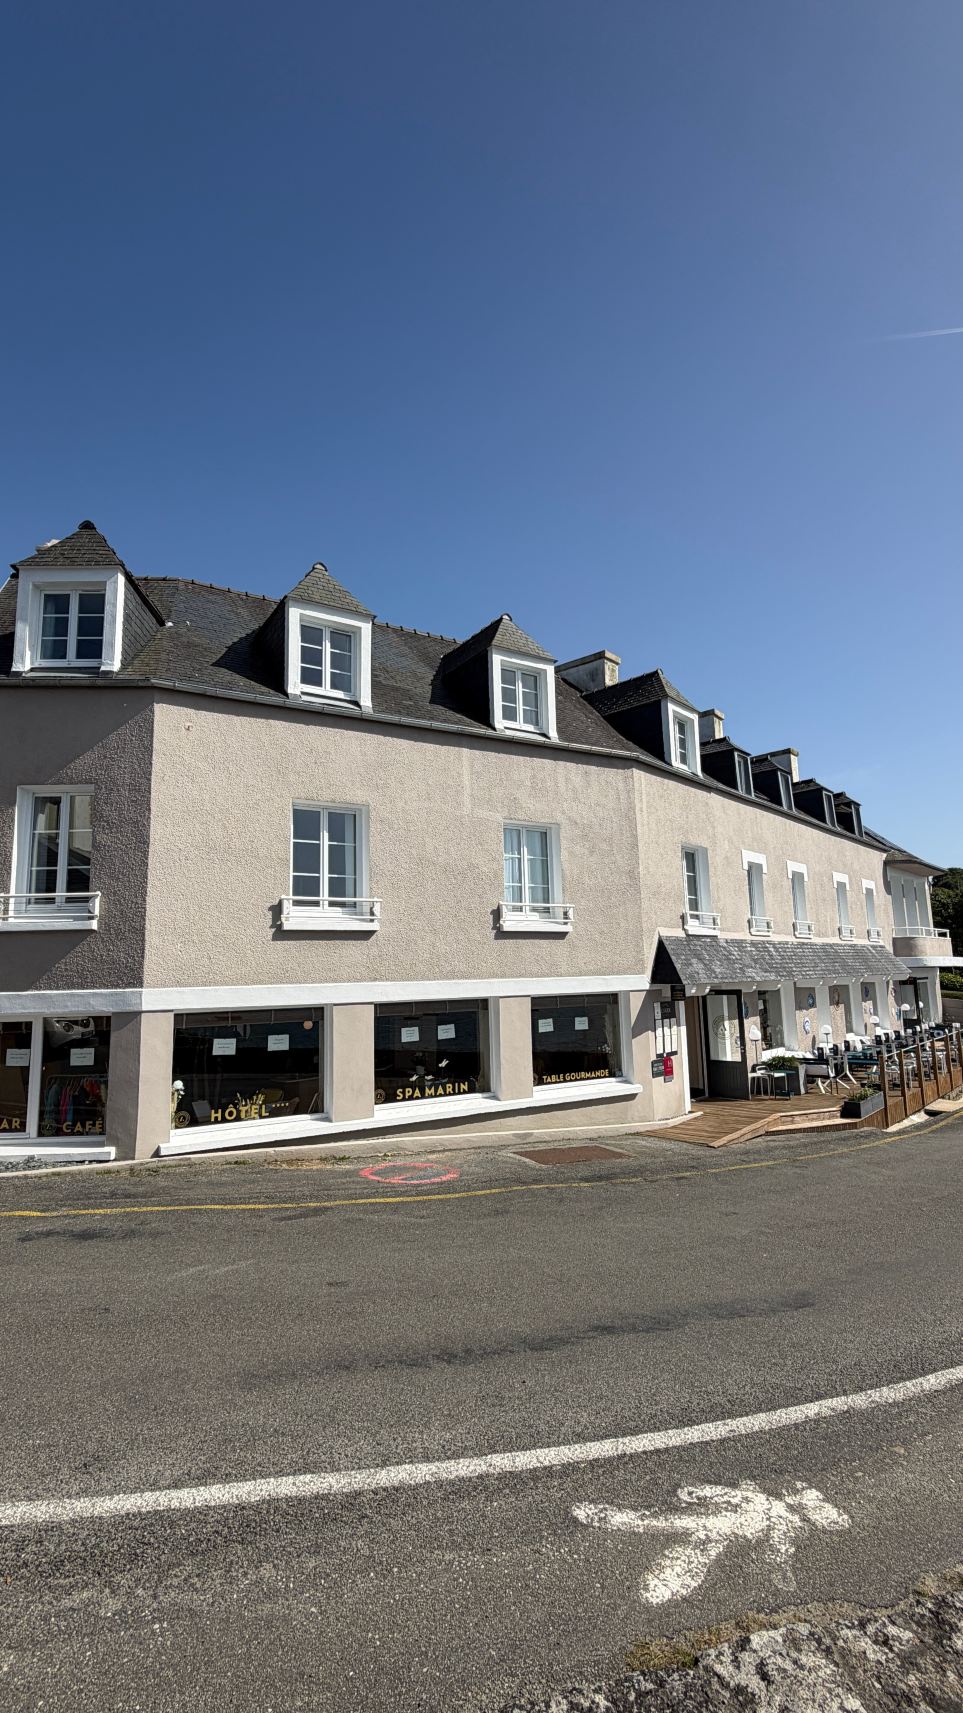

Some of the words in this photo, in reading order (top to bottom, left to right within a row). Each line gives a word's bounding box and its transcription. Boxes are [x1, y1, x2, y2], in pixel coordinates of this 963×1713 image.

[542, 1073, 564, 1083] TABLE
[565, 1069, 609, 1081] GOURMANDE
[396, 1087, 421, 1100] SPA
[425, 1081, 468, 1097] MARIN
[210, 1104, 269, 1122] HÔTEL
[62, 1116, 103, 1132] CAFÉ
